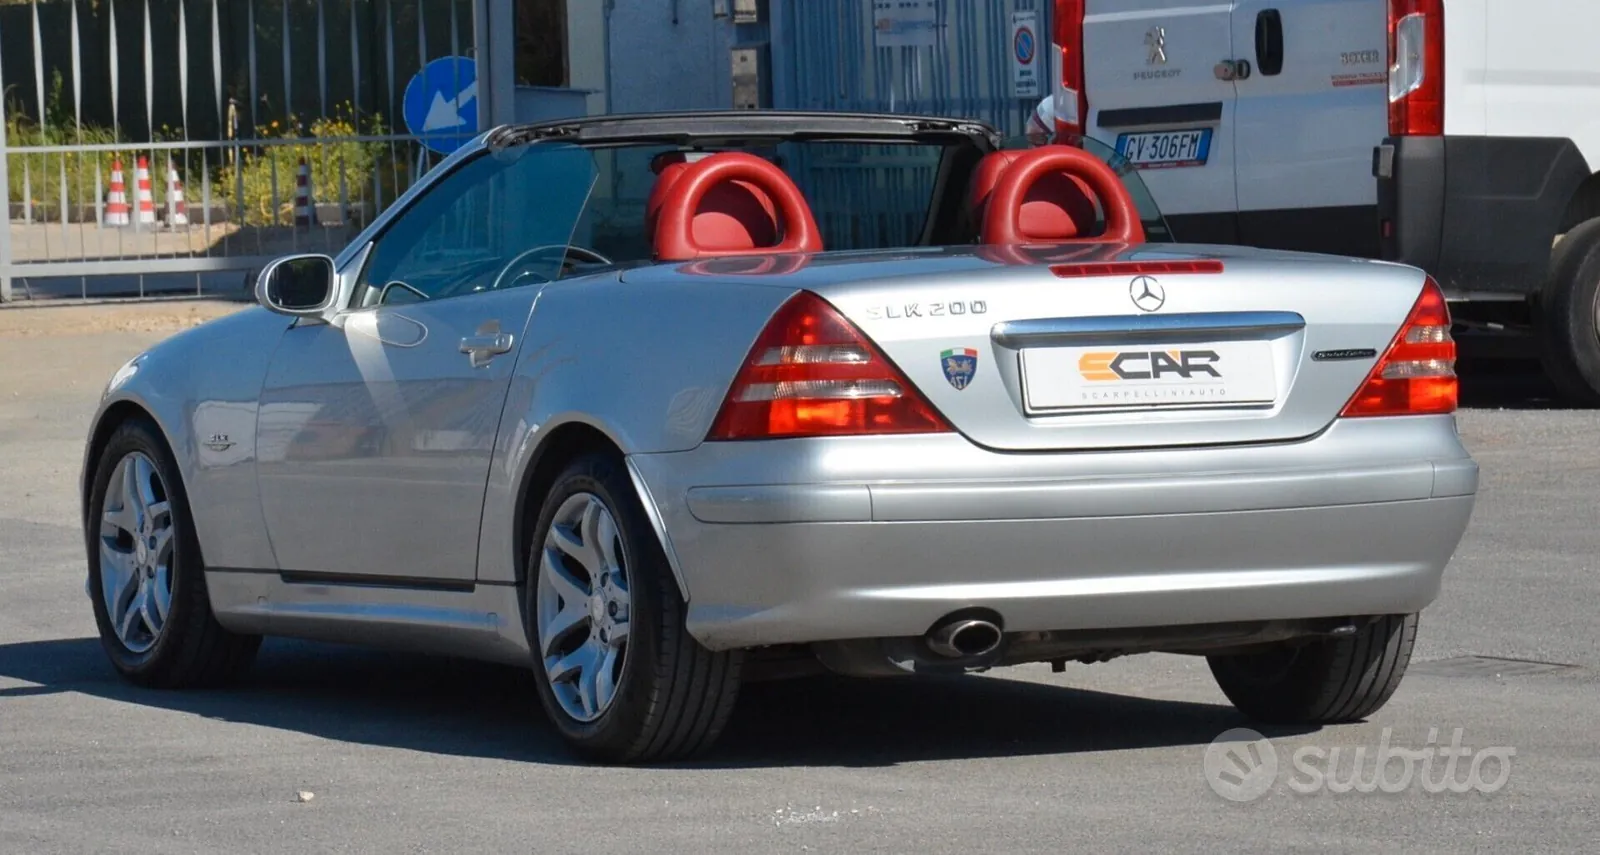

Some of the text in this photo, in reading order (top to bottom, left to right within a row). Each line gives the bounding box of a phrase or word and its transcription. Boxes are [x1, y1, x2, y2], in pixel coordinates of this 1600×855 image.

[1340, 49, 1380, 64] BOXER
[1133, 69, 1182, 80] PEUGEOT
[1126, 133, 1200, 161] GV 306FM
[866, 300, 987, 320] SLK 200
